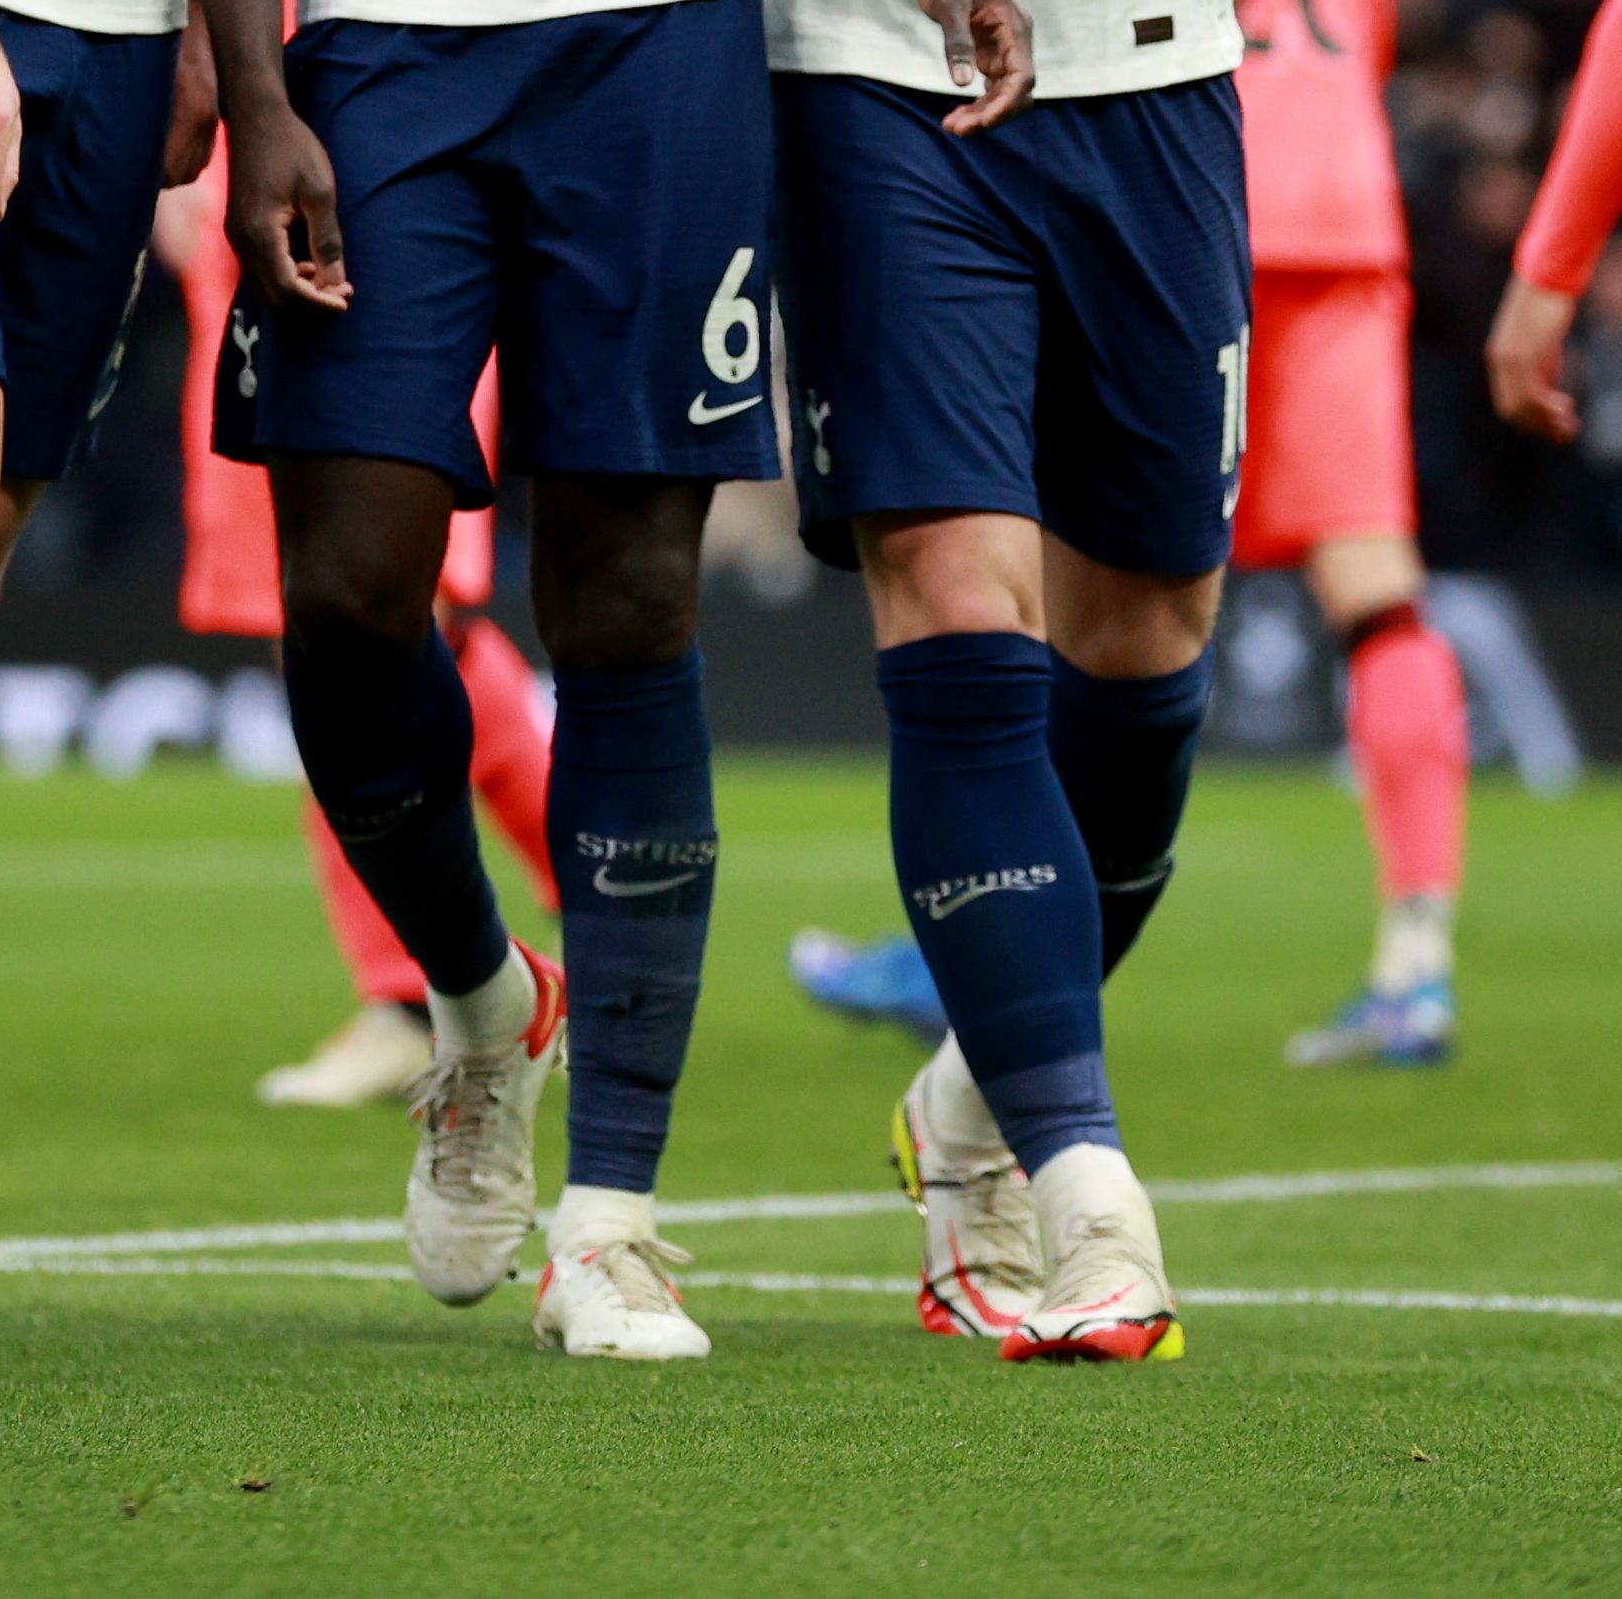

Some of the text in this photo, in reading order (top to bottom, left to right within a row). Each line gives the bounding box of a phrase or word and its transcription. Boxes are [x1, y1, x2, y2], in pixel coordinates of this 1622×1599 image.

[701, 246, 760, 385] 6
[1216, 321, 1251, 476] 1
[576, 831, 718, 866] SPURS
